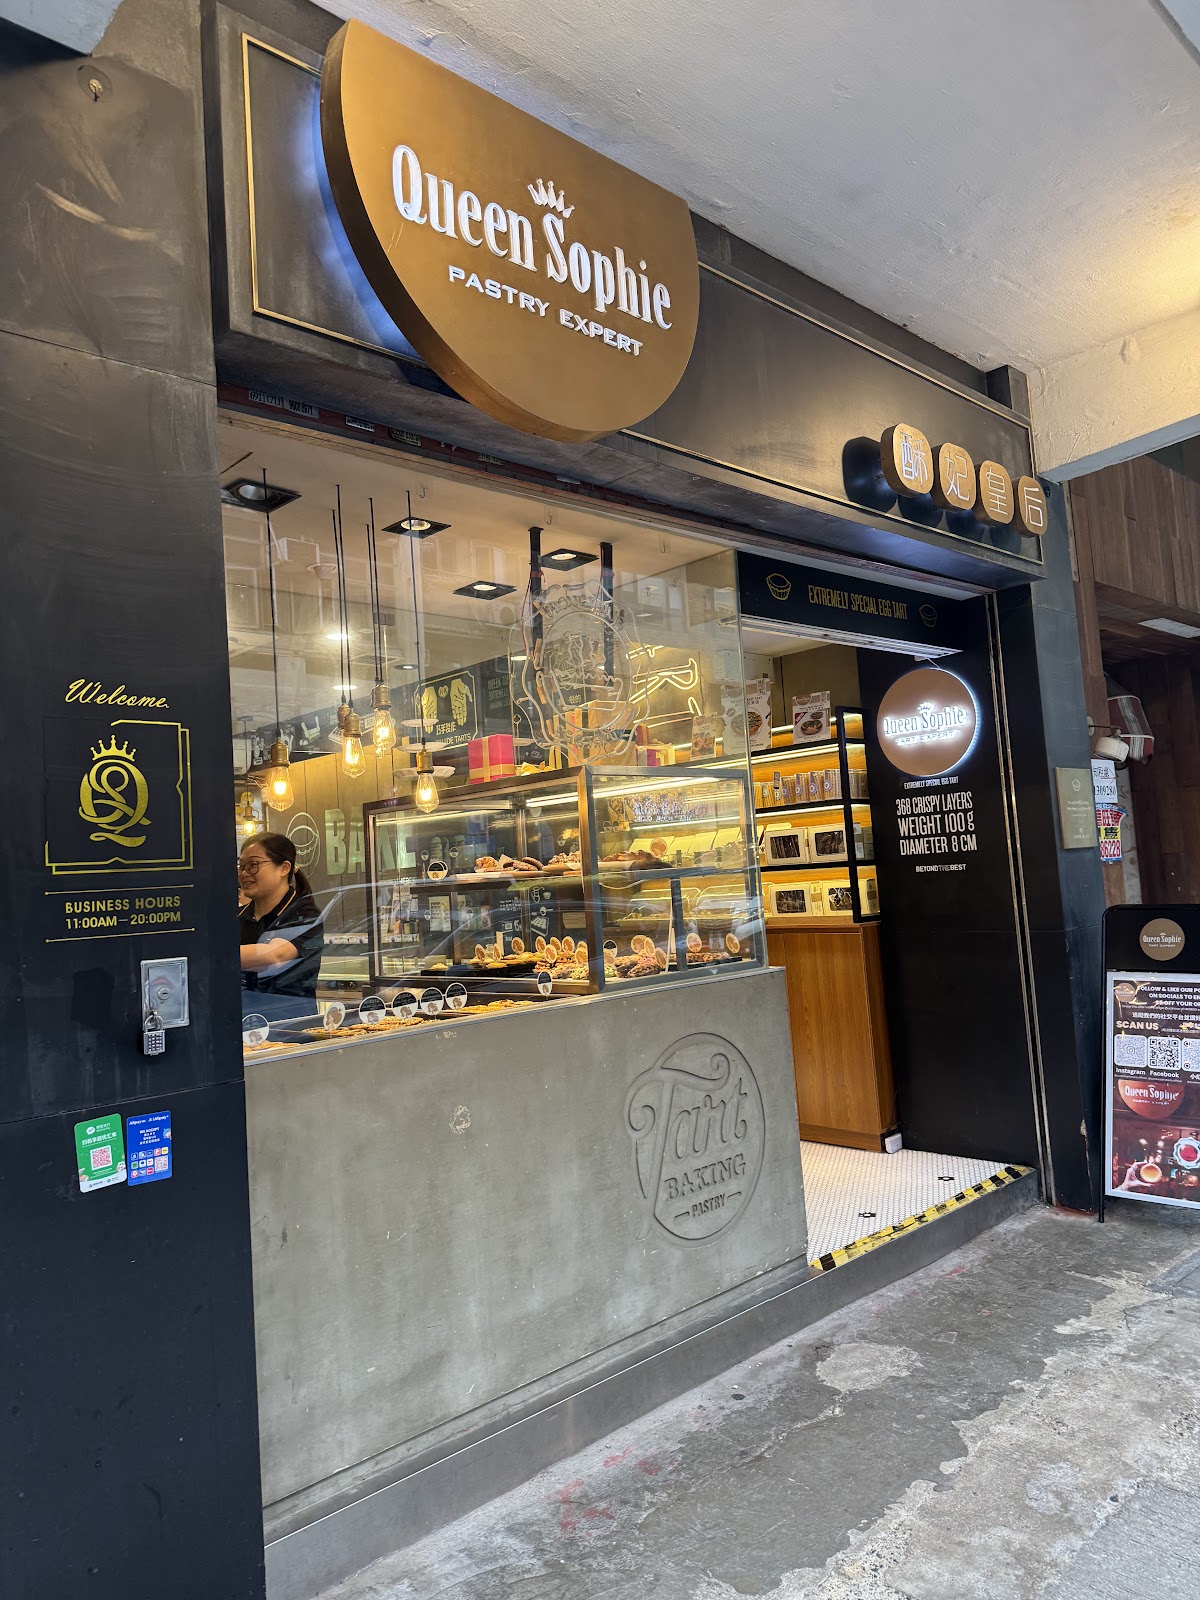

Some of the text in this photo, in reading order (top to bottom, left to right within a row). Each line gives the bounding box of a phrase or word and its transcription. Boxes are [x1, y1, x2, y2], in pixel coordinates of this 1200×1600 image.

[392, 144, 673, 330] Queen Sophie
[448, 265, 644, 356] PASTRY EXPERT
[808, 584, 908, 620] EXTREMELY SPECIAL EGG TART
[64, 678, 170, 709] Welcome
[884, 705, 967, 736] Queen Sophie
[896, 791, 973, 816] 368 CRISPY LAYERS
[897, 814, 942, 837] WEIGHT
[899, 833, 978, 856] DIAMETER 8 CM
[65, 895, 181, 914] BUSINESS HOURS
[1142, 934, 1182, 944] Queen Sophie
[1115, 1020, 1160, 1031] SCAN US
[1115, 1067, 1146, 1076] Instagram
[1149, 1070, 1180, 1079] Facebook
[1124, 1085, 1149, 1098] Queen
[664, 1153, 747, 1202] BAKING
[691, 1193, 726, 1217] PASTRY
